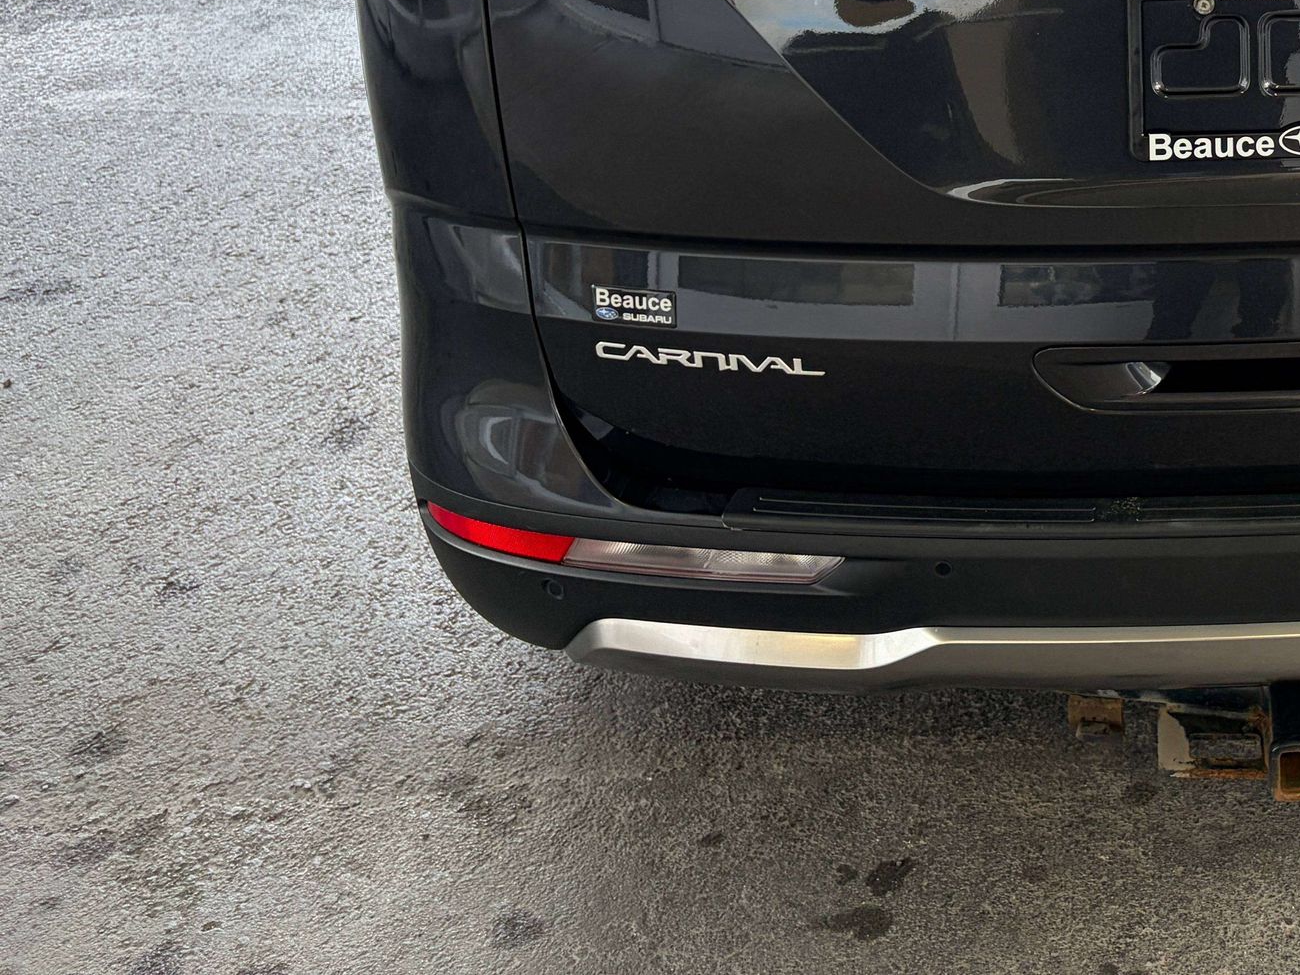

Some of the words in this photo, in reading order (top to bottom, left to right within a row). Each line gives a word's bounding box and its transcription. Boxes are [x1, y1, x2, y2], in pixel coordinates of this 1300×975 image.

[1148, 133, 1275, 161] Beauce
[595, 288, 672, 312] Beauce
[622, 312, 672, 324] SUBARU
[595, 341, 826, 376] CARNIVAL
